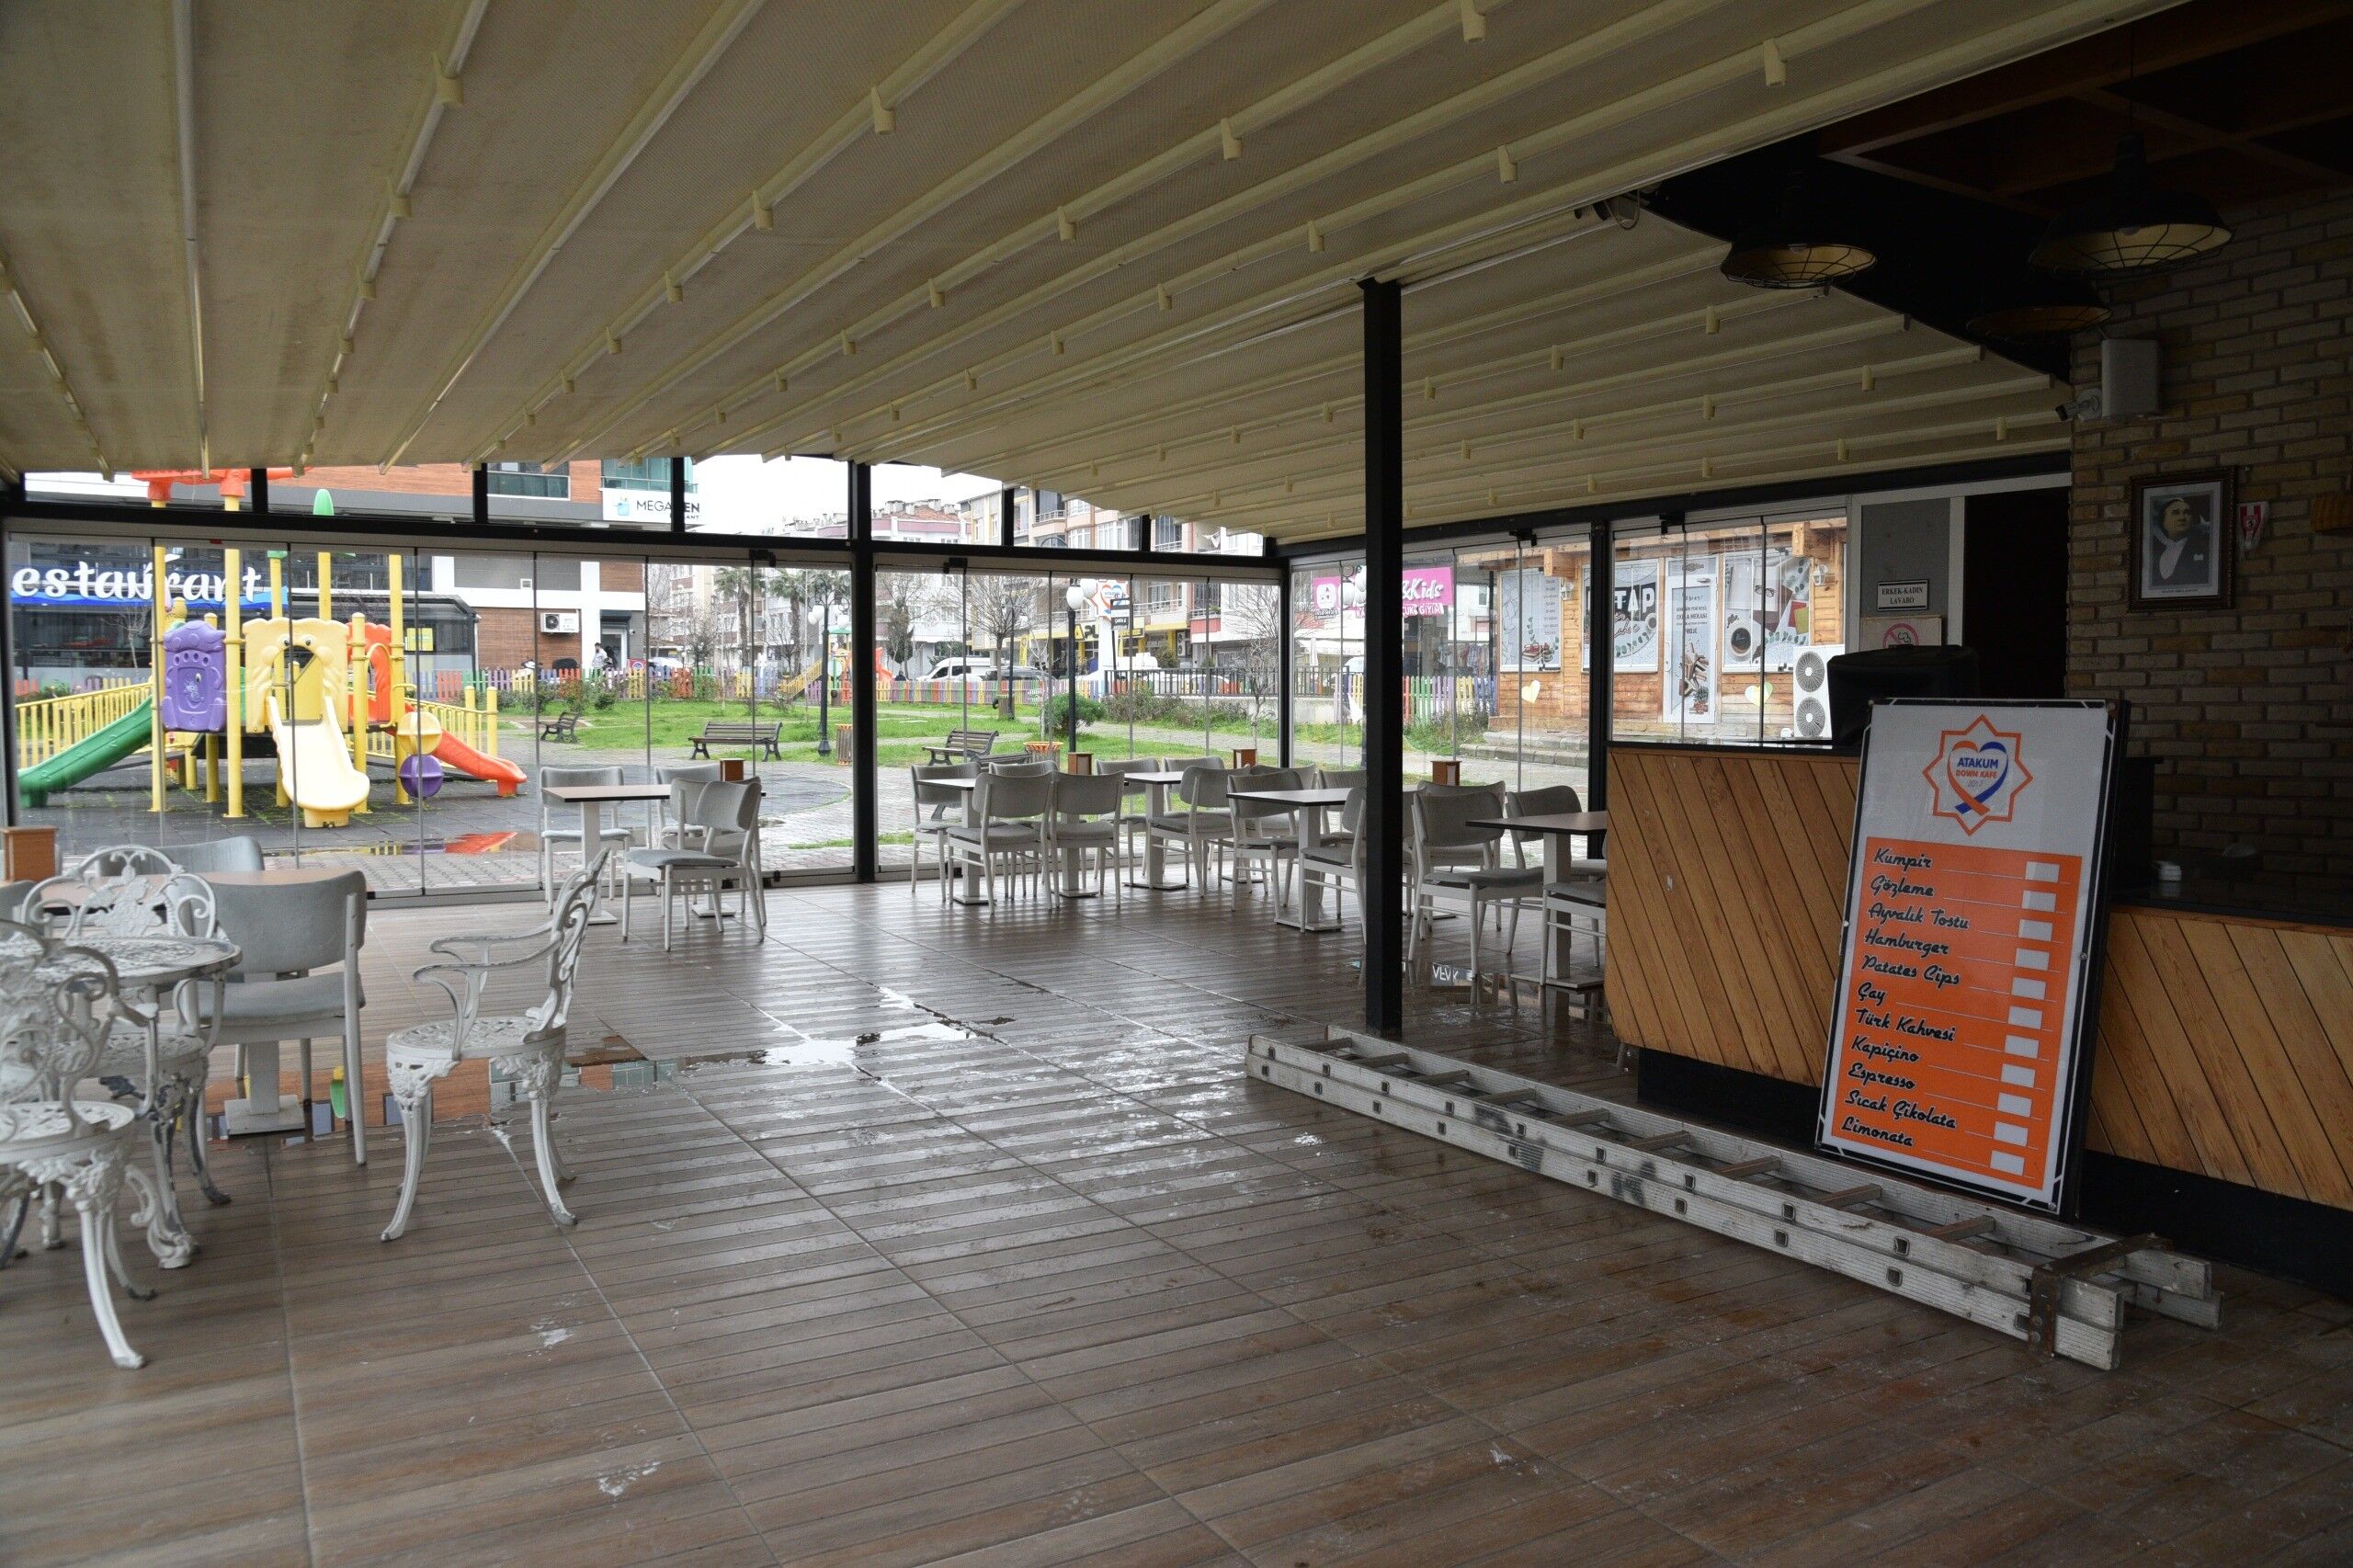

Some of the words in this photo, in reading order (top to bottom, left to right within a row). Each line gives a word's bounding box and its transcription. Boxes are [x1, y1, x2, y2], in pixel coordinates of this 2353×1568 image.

[636, 500, 700, 513] MEGAEN
[12, 560, 262, 603] estaurant
[1881, 586, 1924, 596] ERKEK-KADIN
[1955, 769, 1978, 778] DOWN
[1980, 770, 1998, 778] KAFE
[1957, 757, 1999, 768] ATAKUM
[1873, 848, 1933, 871] Kumpir
[1870, 875, 1935, 898] Gözleme
[1868, 902, 1925, 925] Ayvalık
[1930, 907, 1970, 929] Tostu
[1864, 928, 1949, 959] Hamburger
[1860, 954, 1917, 978] Patates
[1923, 964, 1961, 989] Cips
[1858, 982, 1887, 1006] Çay
[1855, 1007, 1892, 1029] Türk
[1895, 1016, 1956, 1041] Kahvesi
[1850, 1035, 1920, 1062] Kapiçino
[1847, 1062, 1916, 1090] Espresso
[1844, 1089, 1888, 1112] Sıcak
[1893, 1099, 1957, 1129] Çikolata
[1841, 1116, 1915, 1147] Limonata
